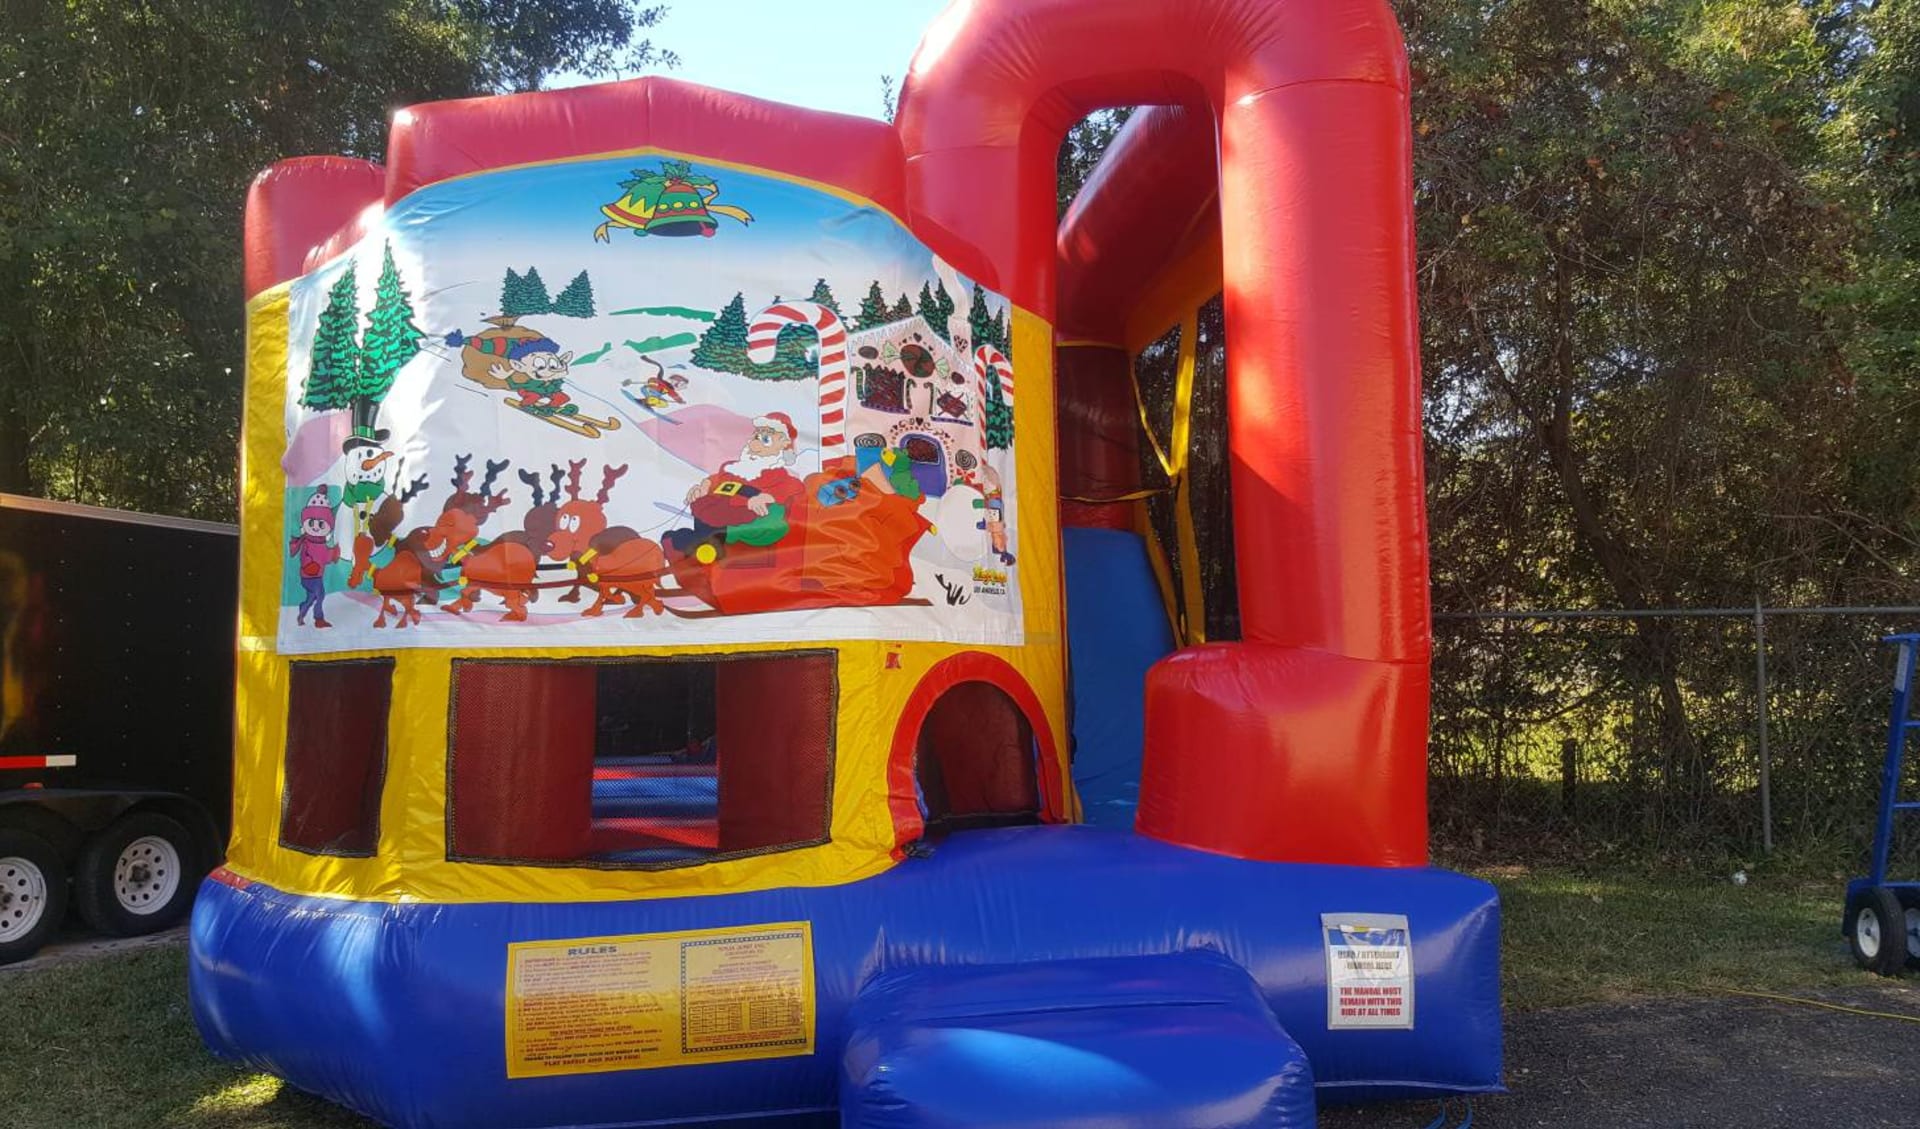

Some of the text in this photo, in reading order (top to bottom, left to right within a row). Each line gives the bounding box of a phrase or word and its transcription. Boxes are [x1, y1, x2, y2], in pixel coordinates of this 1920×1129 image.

[568, 945, 617, 955] RULES
[1340, 987, 1401, 995] THE MANUAL MUST
[1340, 997, 1402, 1006] REMAIN WITH THIS
[1341, 1008, 1400, 1016] RIDE AT ALL TIMES
